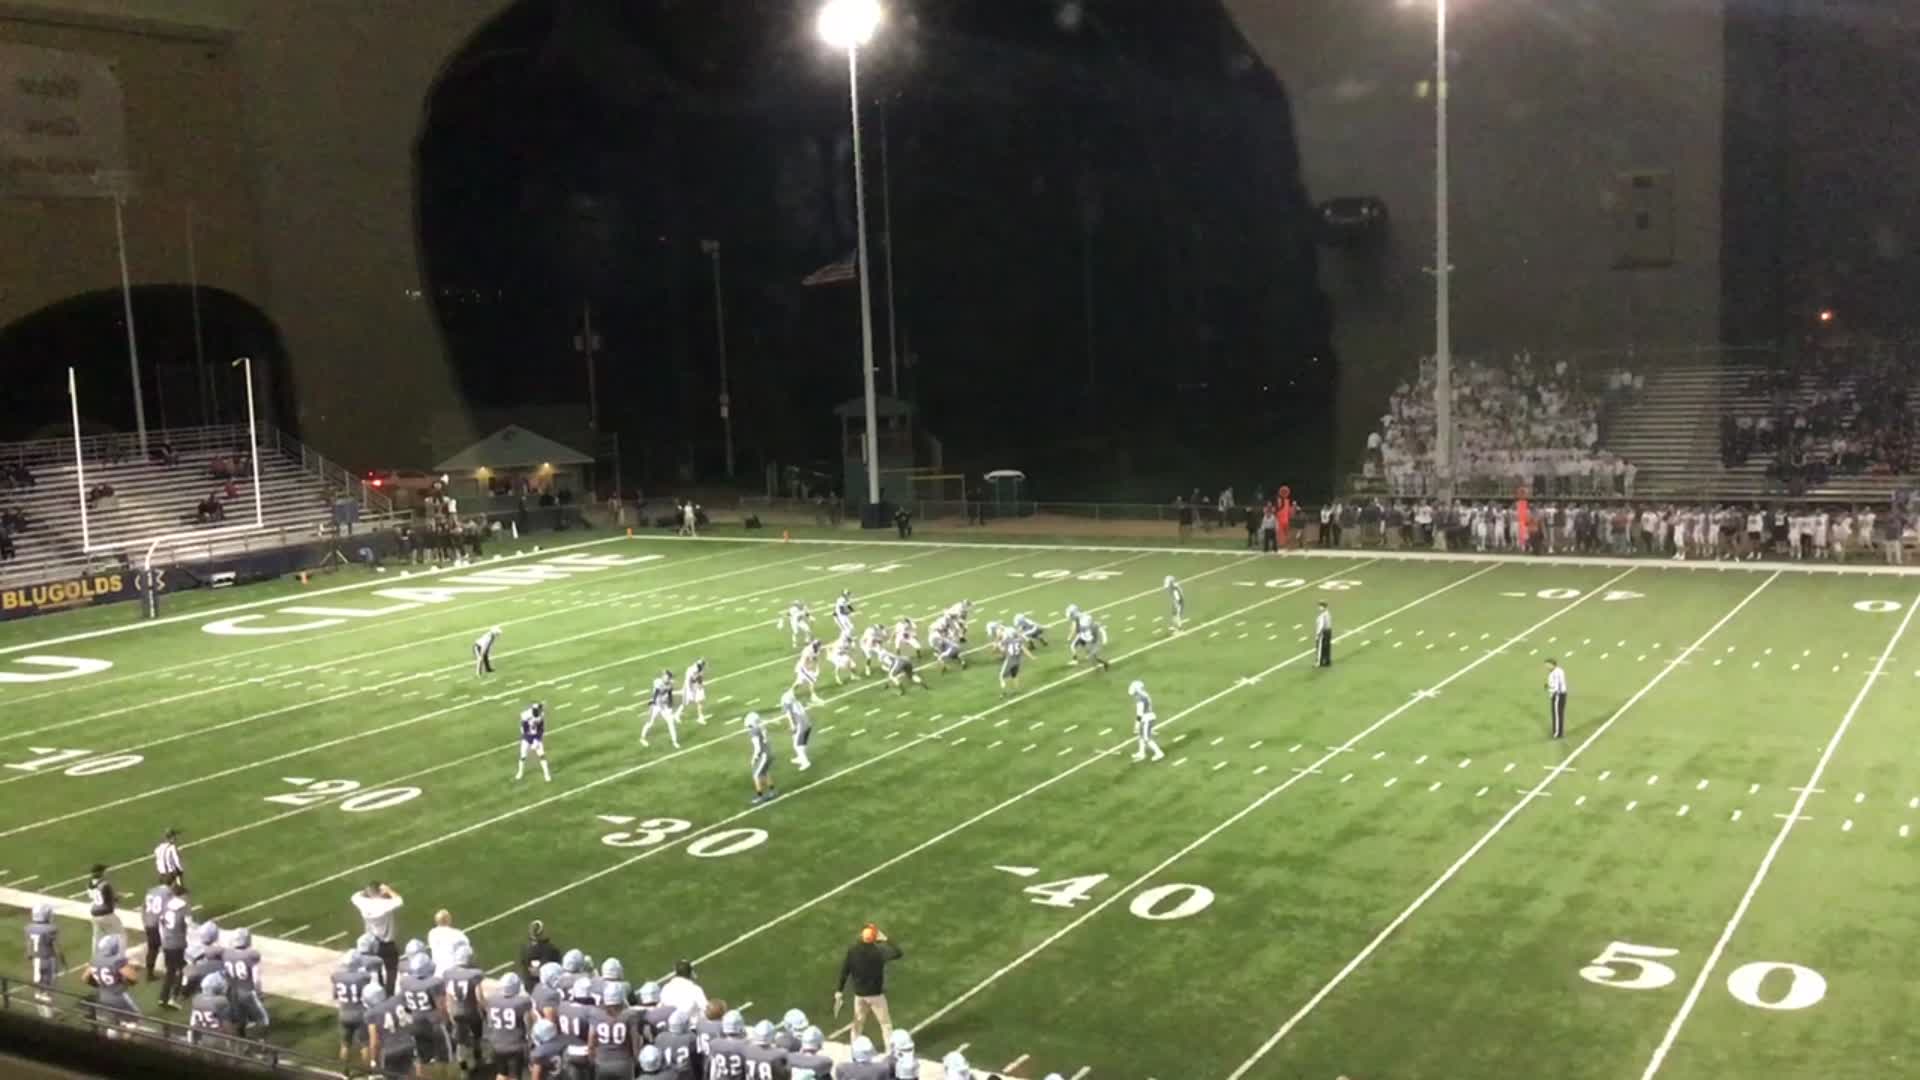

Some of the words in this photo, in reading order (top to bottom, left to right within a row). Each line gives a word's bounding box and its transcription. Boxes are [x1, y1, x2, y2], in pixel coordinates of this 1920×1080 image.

[2, 575, 123, 610] BLUGOLDS
[201, 552, 666, 636] CLAIRE
[335, 982, 359, 1003] 21
[489, 1007, 517, 1030] 59
[596, 1022, 627, 1045] 90
